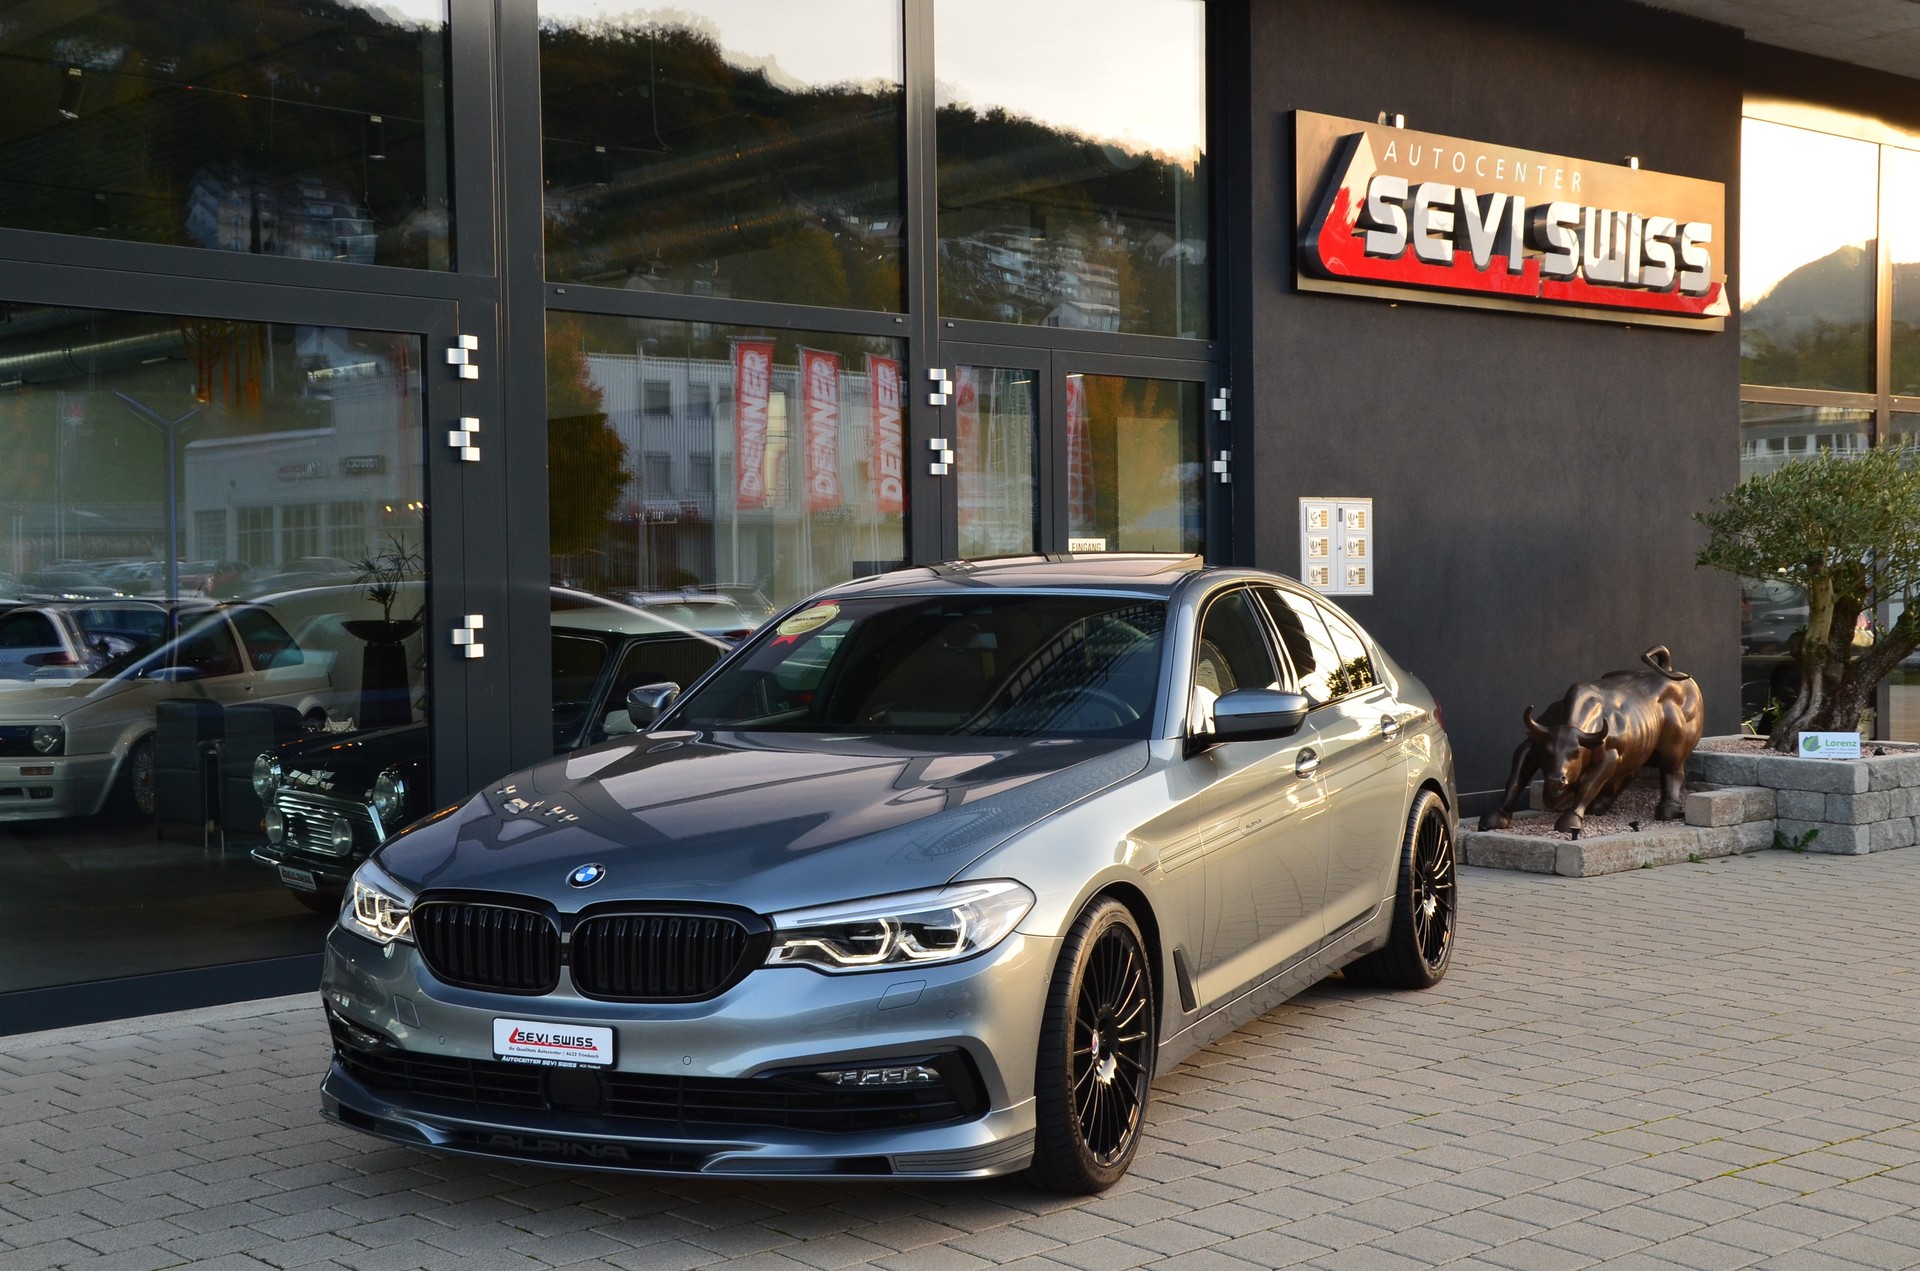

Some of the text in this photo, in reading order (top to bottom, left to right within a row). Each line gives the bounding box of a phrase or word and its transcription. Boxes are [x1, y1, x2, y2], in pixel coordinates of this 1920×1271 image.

[1383, 139, 1583, 193] AUTOCENTER
[1365, 174, 1712, 294] SEVI SWISS
[741, 350, 769, 498] DENNER
[811, 357, 838, 498] DENNER
[878, 362, 903, 500] DENNER
[1071, 542, 1102, 551] EINGANG
[1825, 739, 1857, 747] Lorenz
[517, 1031, 593, 1048] SEVI SWISS
[501, 1055, 541, 1065] AUTOCENTER
[558, 1061, 577, 1069] SWISS
[489, 1133, 630, 1160] ALPINA
